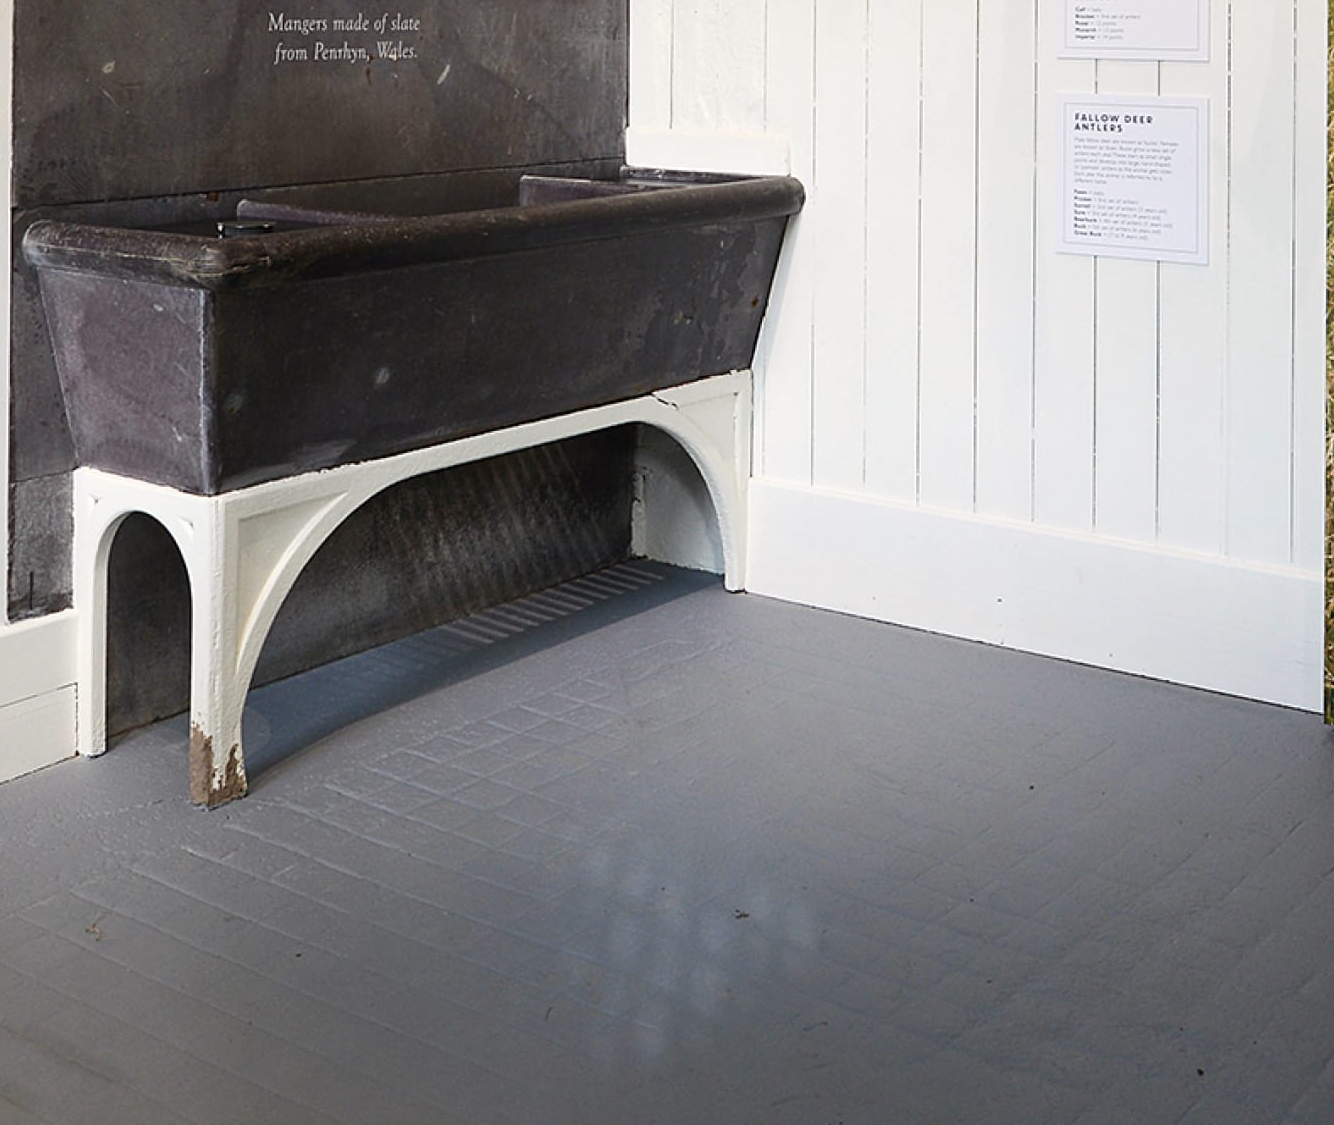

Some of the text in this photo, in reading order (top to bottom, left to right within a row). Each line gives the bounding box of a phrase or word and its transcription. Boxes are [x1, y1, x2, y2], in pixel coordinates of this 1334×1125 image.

[268, 12, 421, 36] Mangers made of slate
[274, 40, 418, 65] from Penrhyn, Wales.
[1074, 112, 1153, 124] FALLOW DEER
[1074, 122, 1123, 133] ANTLERS
